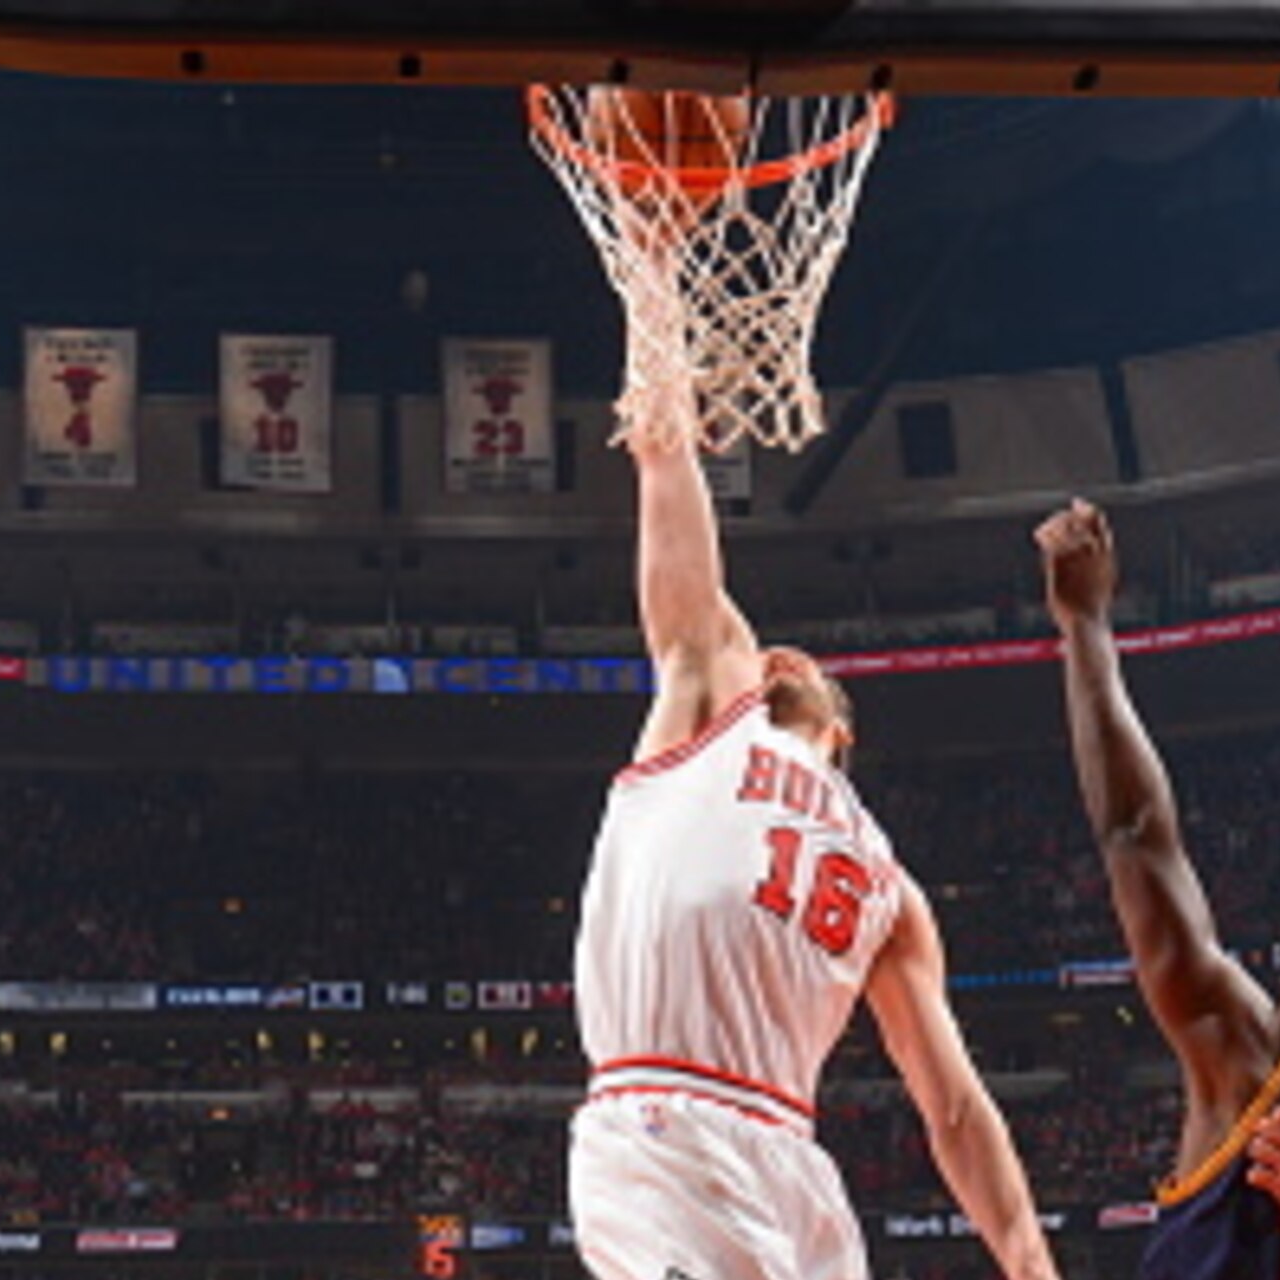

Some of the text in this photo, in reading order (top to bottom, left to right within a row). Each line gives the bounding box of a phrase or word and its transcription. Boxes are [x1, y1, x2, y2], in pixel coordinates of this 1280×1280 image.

[65, 410, 91, 448] 4
[255, 414, 297, 453] 10
[473, 419, 524, 455] 23
[50, 659, 349, 692] UNITED
[752, 826, 871, 956] 16
